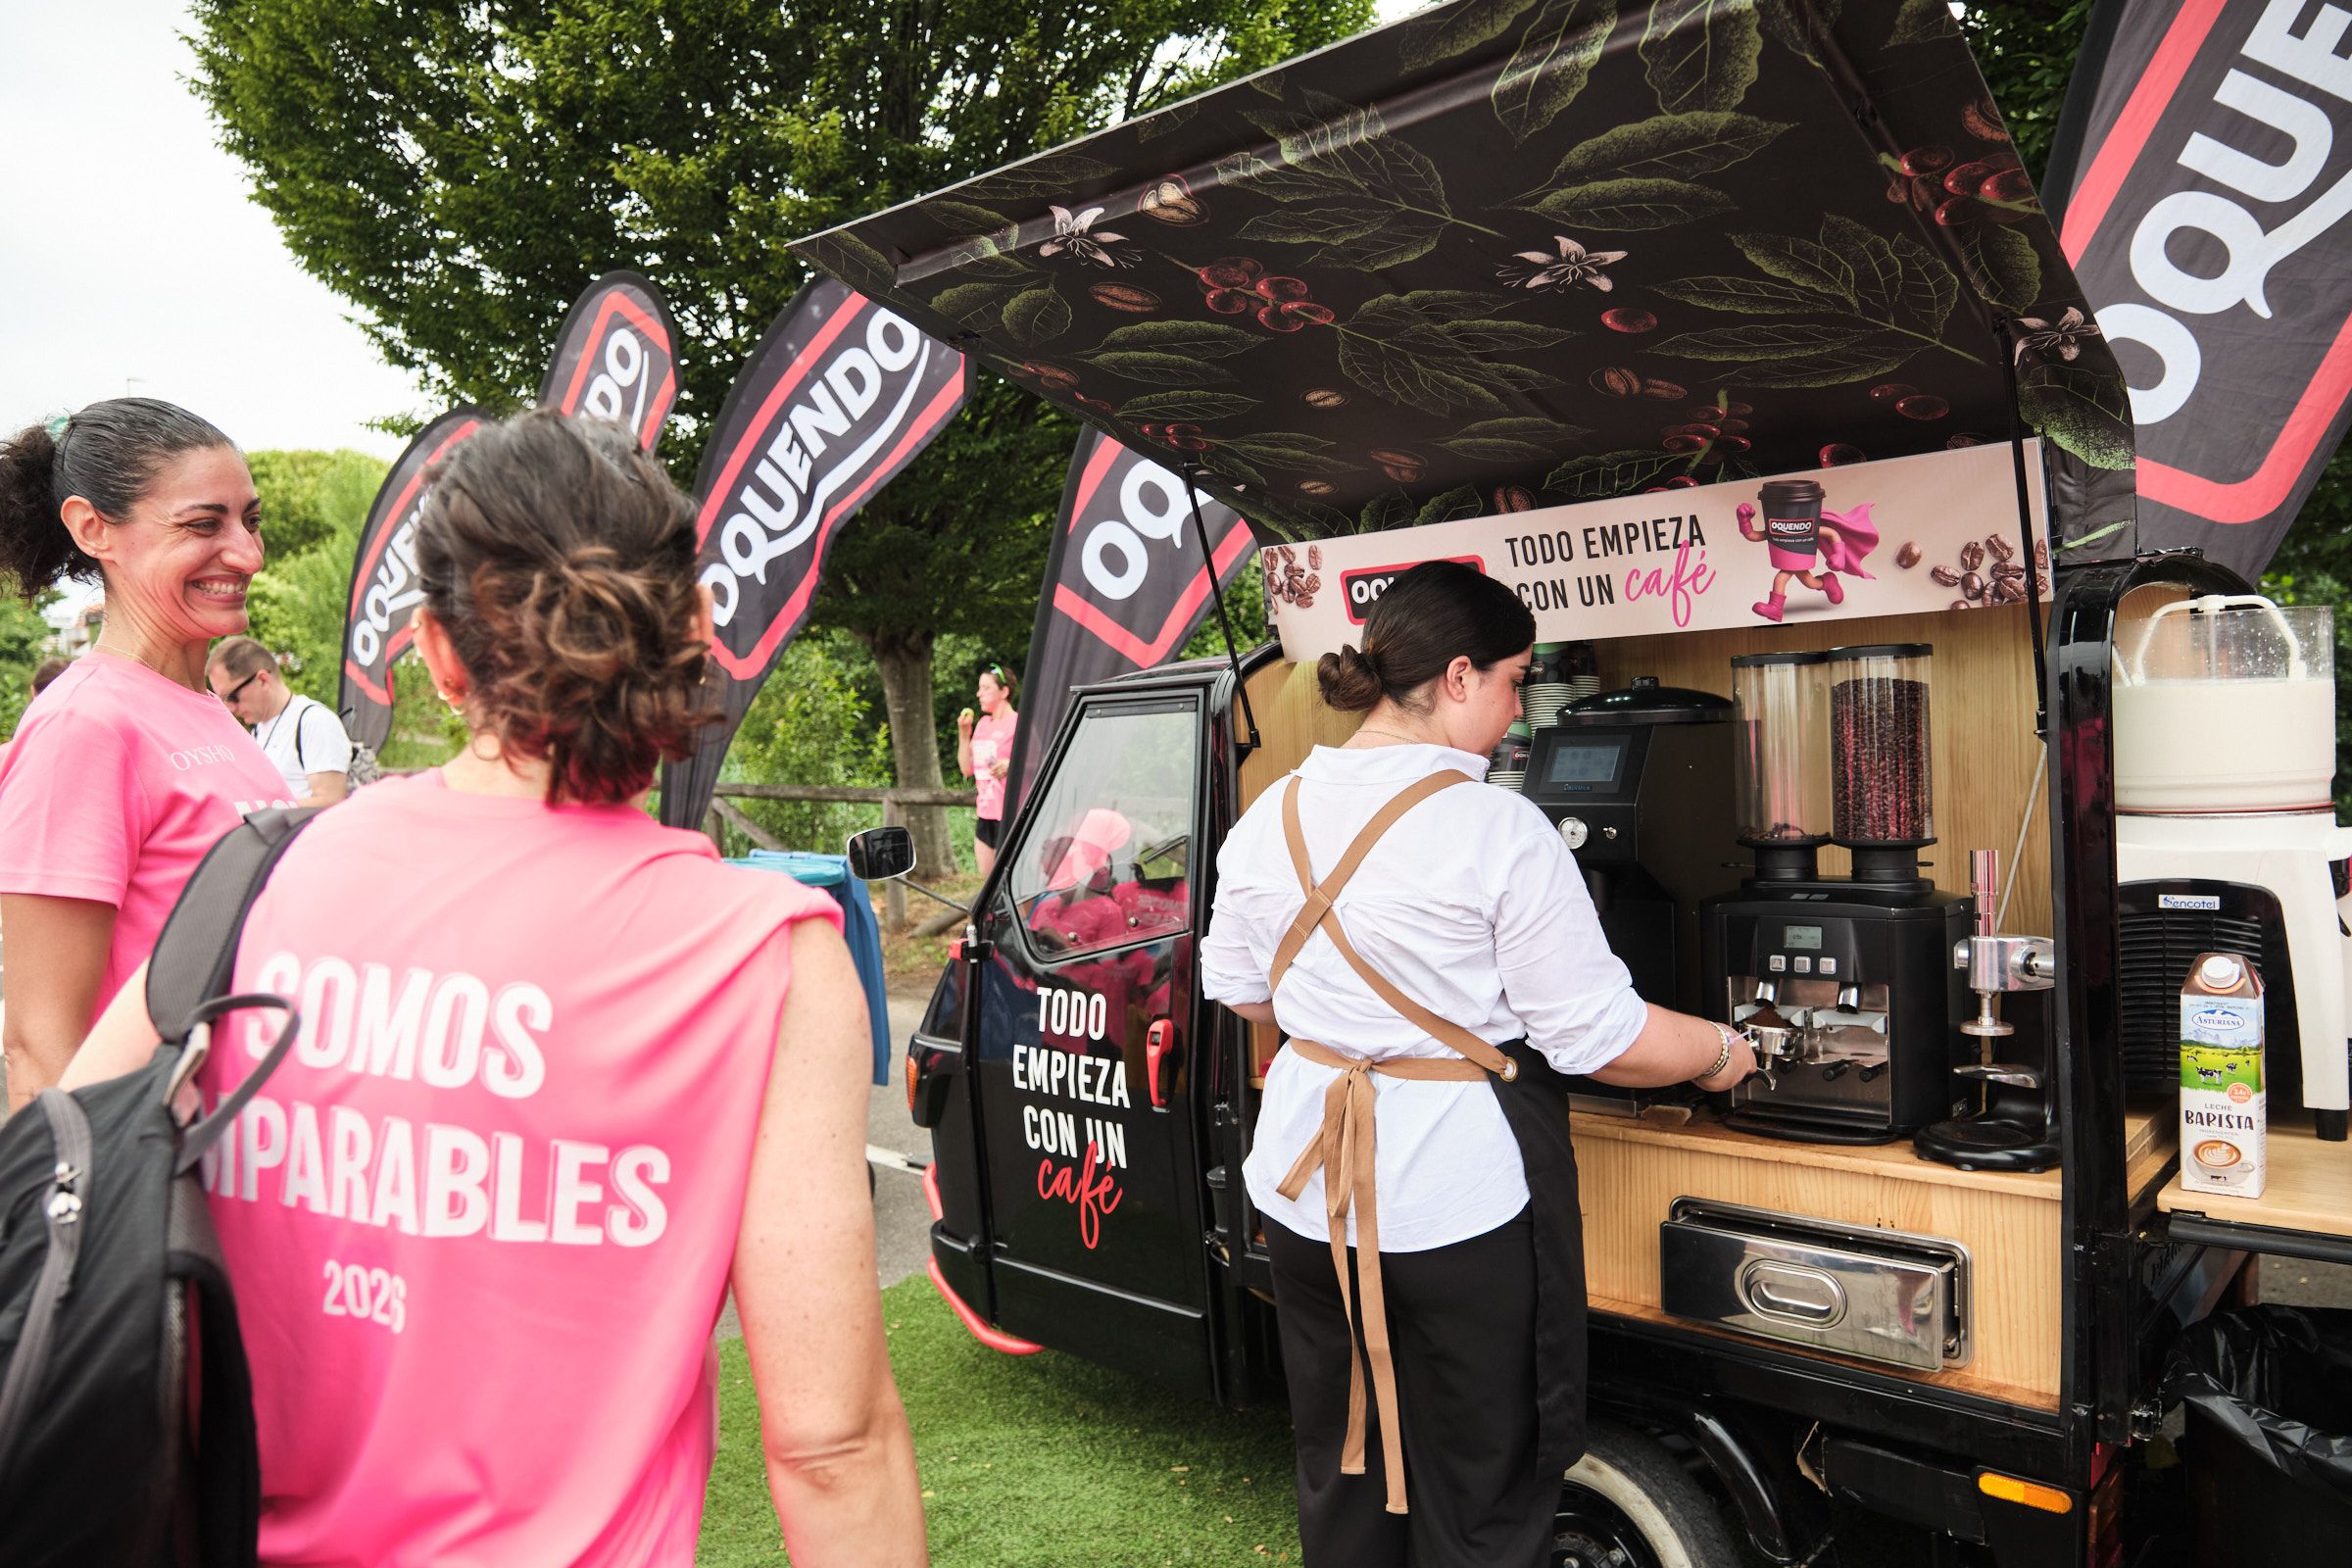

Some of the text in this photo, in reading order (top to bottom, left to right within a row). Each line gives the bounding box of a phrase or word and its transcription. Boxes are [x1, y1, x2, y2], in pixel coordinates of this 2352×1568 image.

[700, 308, 930, 626] OQUENDO
[1505, 514, 1706, 567] TODO EMPIEZA
[1771, 521, 1812, 534] OQUENDO
[353, 485, 427, 666] OQUE
[1517, 540, 1716, 627] CON UN café
[171, 745, 235, 771] OYSHO
[246, 952, 552, 1099] SOMOS
[1037, 987, 1107, 1041] TODO
[2197, 1016, 2240, 1026] ASTURIANA
[1012, 1044, 1131, 1108] EMPIEZA
[1023, 1104, 1128, 1169] CON UN
[2185, 1109, 2254, 1131] BARISTA
[1037, 1140, 1123, 1250] café
[323, 1261, 407, 1333] 2026
